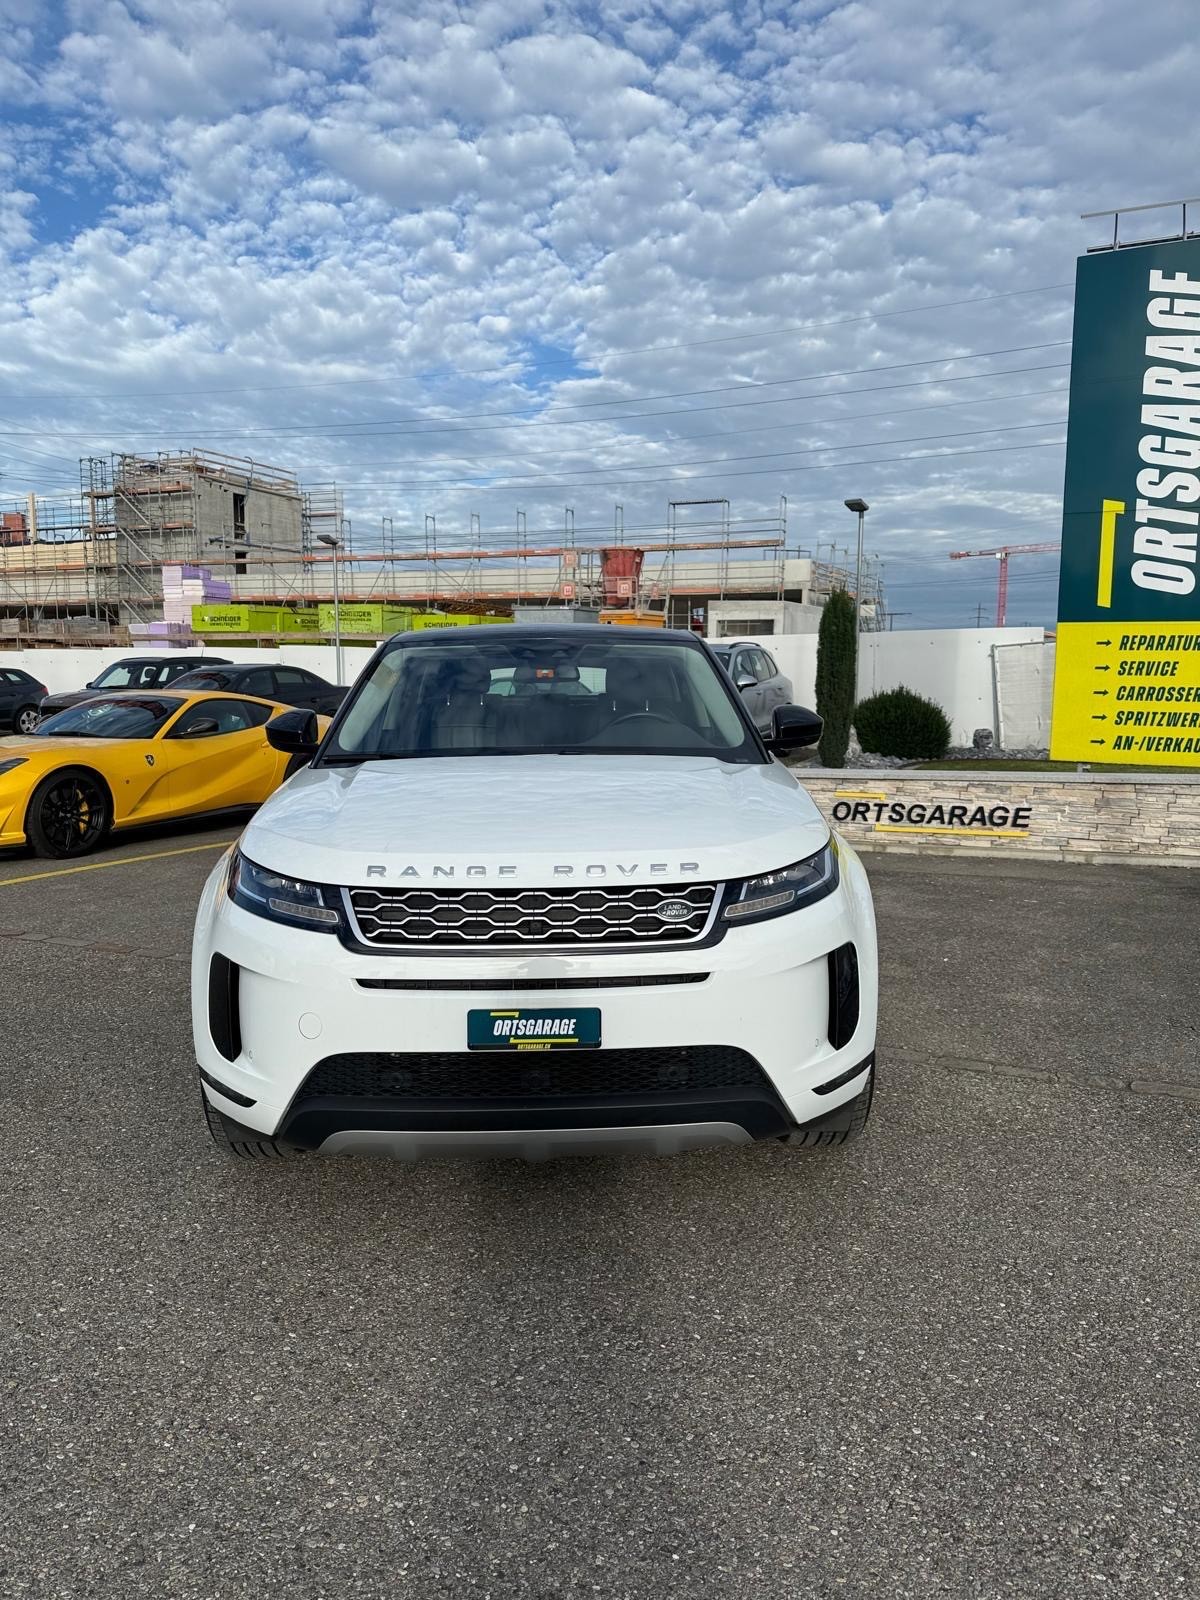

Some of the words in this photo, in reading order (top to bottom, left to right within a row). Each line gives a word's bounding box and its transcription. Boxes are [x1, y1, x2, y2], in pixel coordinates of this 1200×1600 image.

[1131, 269, 1200, 595] ORTSGARAGE
[1117, 660, 1179, 676] SERVICE
[1114, 711, 1200, 728] SPRITZWER
[832, 801, 1032, 828] ORTSGARAGE
[366, 864, 518, 878] RANGE
[553, 862, 700, 878] ROVER
[493, 1018, 577, 1036] ORTSGARAGE
